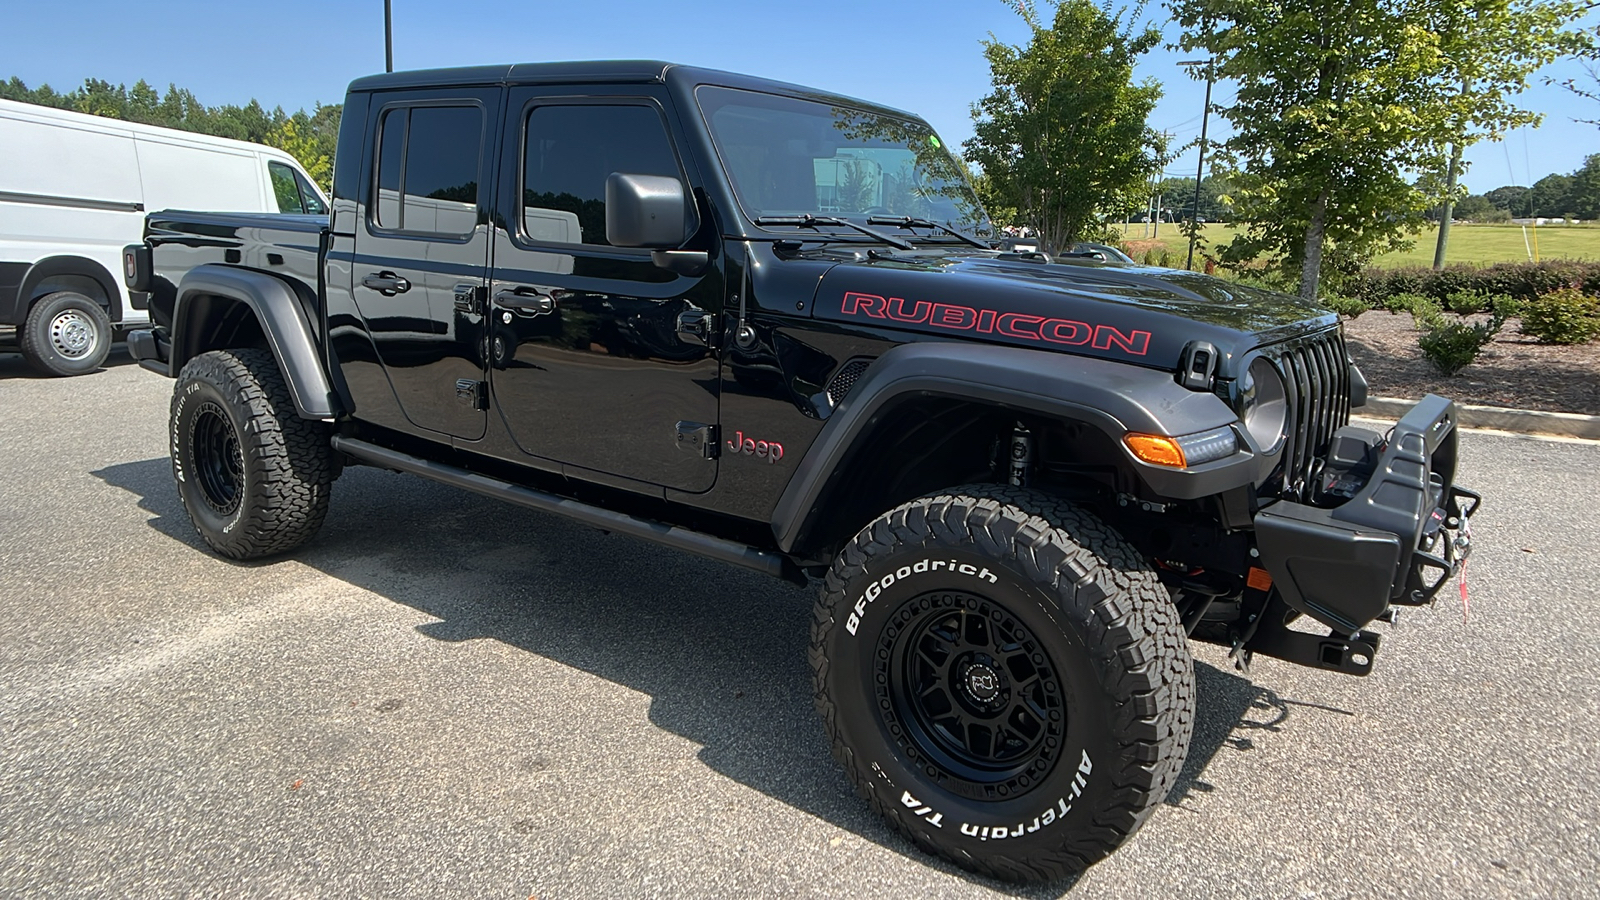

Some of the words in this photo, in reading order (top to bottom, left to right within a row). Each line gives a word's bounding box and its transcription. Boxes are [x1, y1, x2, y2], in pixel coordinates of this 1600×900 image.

[841, 291, 1152, 356] RUBICON
[187, 382, 200, 395] T/A
[728, 431, 784, 463] Jeep
[845, 559, 998, 635] BFGoodrich
[901, 790, 943, 828] T/A
[961, 749, 1092, 841] All-Terrain
